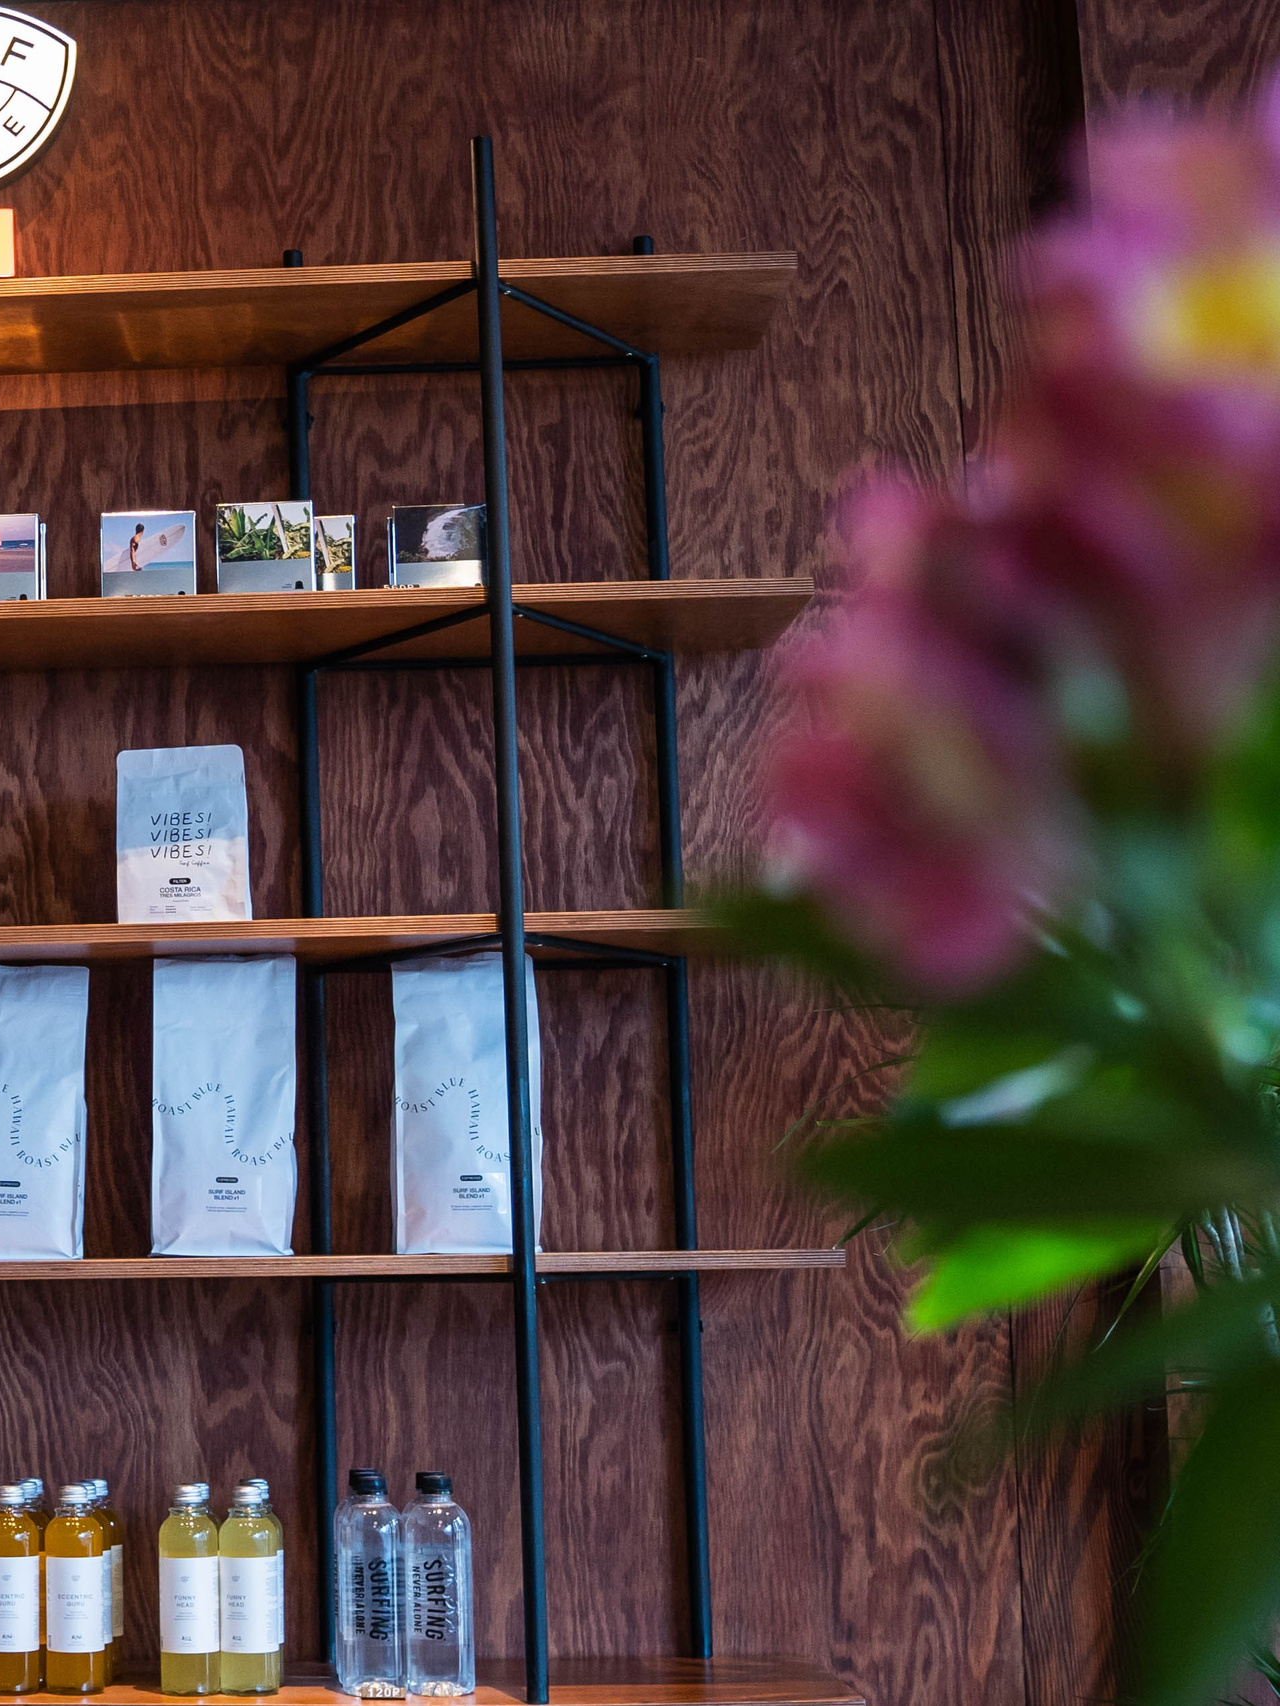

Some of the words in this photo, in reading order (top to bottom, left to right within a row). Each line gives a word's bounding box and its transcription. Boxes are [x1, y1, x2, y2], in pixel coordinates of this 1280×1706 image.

[150, 812, 212, 826] VIBES!
[150, 828, 212, 842] VIBES!
[150, 844, 212, 859] VIBES!
[10, 1094, 22, 1146] HAWAII
[16, 1150, 59, 1168] ROAST
[59, 1132, 81, 1152] BLU
[192, 1083, 223, 1100] BLUE
[224, 1094, 235, 1144] HAWAII
[231, 1149, 273, 1166] ROAST
[274, 1132, 294, 1150] BLU
[436, 1078, 466, 1097] BLUE
[468, 1089, 480, 1141] HAWAII
[476, 1145, 511, 1162] ROAS
[412, 1566, 421, 1598] NEVER
[368, 1557, 390, 1641] SURFING
[423, 1559, 446, 1640] SURFING
[355, 1603, 365, 1634] ALONE
[413, 1602, 422, 1633] ALONE
